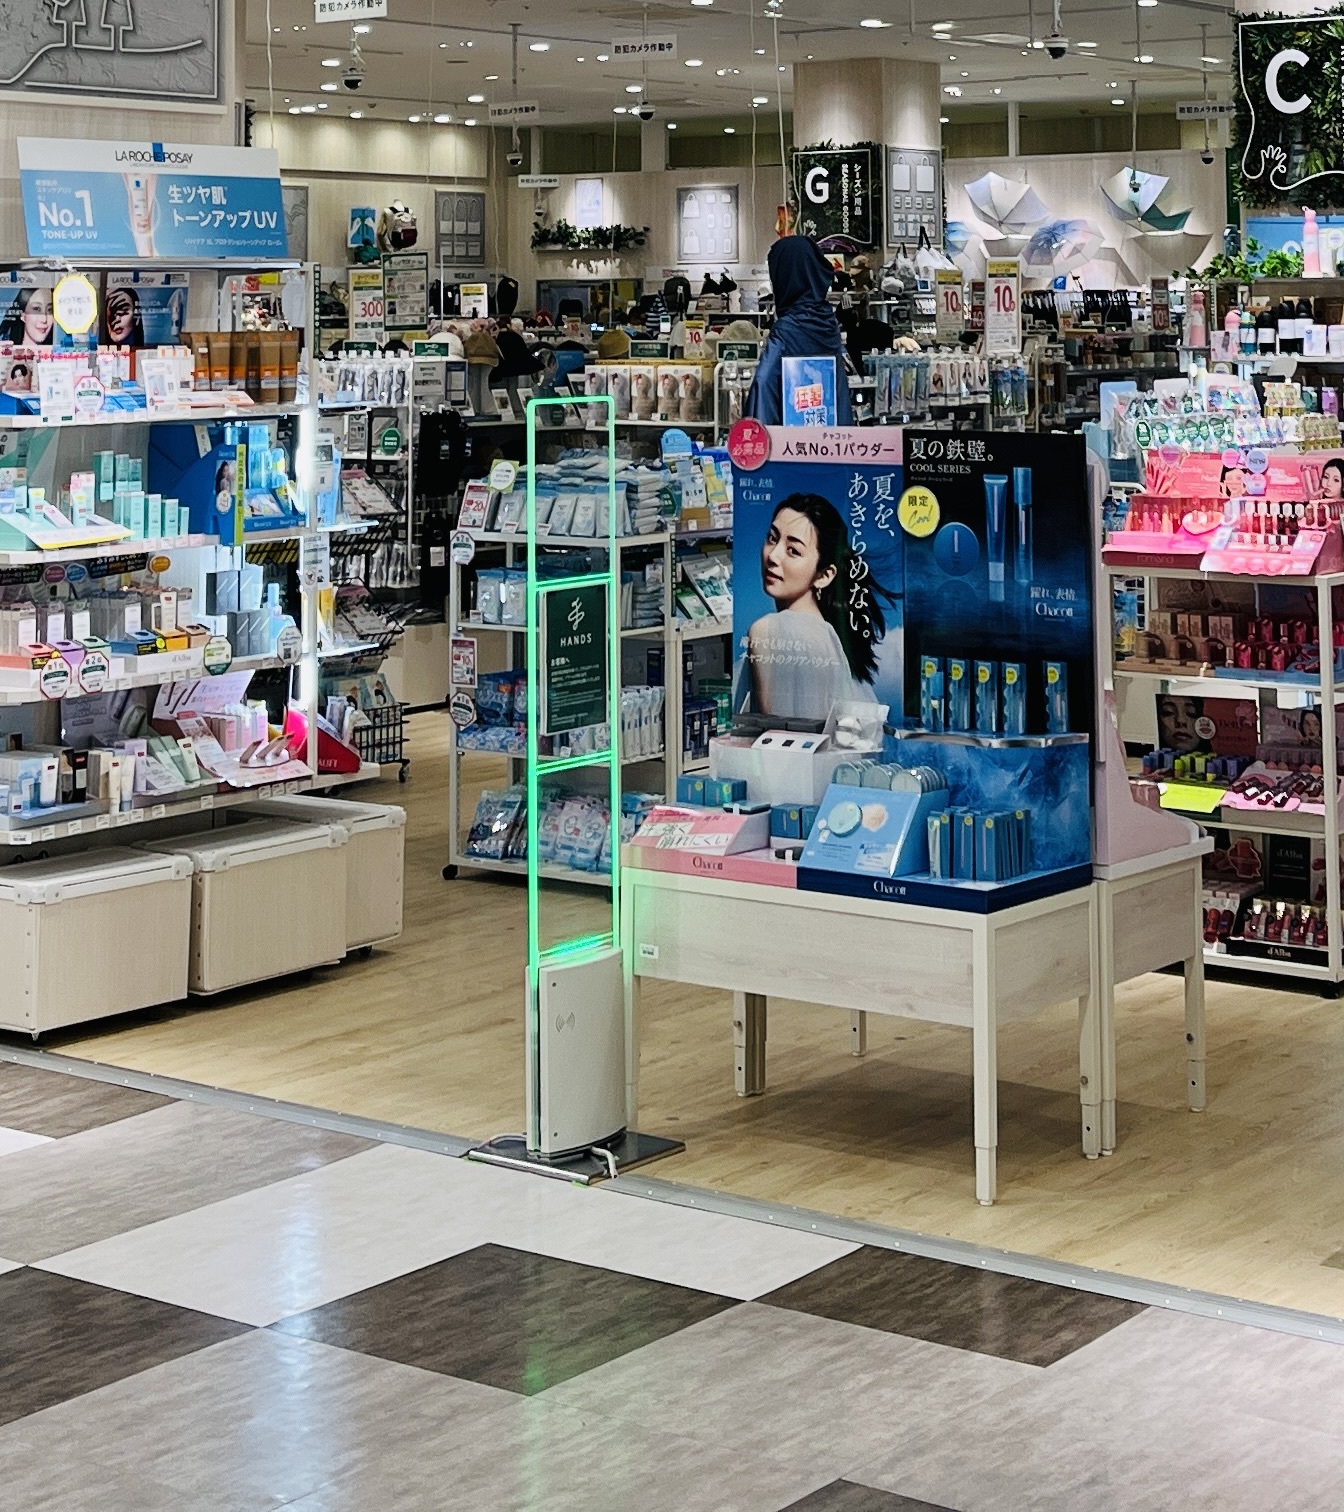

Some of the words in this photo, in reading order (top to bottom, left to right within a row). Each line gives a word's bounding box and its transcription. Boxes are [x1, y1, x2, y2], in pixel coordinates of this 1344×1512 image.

[615, 40, 673, 55] 防犯カメラ作動中
[1265, 49, 1312, 114] C
[805, 166, 829, 203] G
[168, 184, 227, 206] 生ツヤ肌
[39, 190, 94, 227] No.1
[173, 210, 278, 229] トーンアップUV
[41, 230, 83, 239] TONE-UP
[85, 230, 98, 239] UV
[361, 301, 383, 317] 300
[782, 441, 895, 458] 人気No.1パウダー
[909, 437, 994, 462] 夏の鉄壁。
[910, 463, 935, 474] COOL
[937, 464, 971, 475] SERIES
[872, 473, 895, 536] 夏を、
[908, 496, 928, 506] 限定
[849, 472, 871, 639] あきらめない。
[560, 633, 592, 648] HANDS
